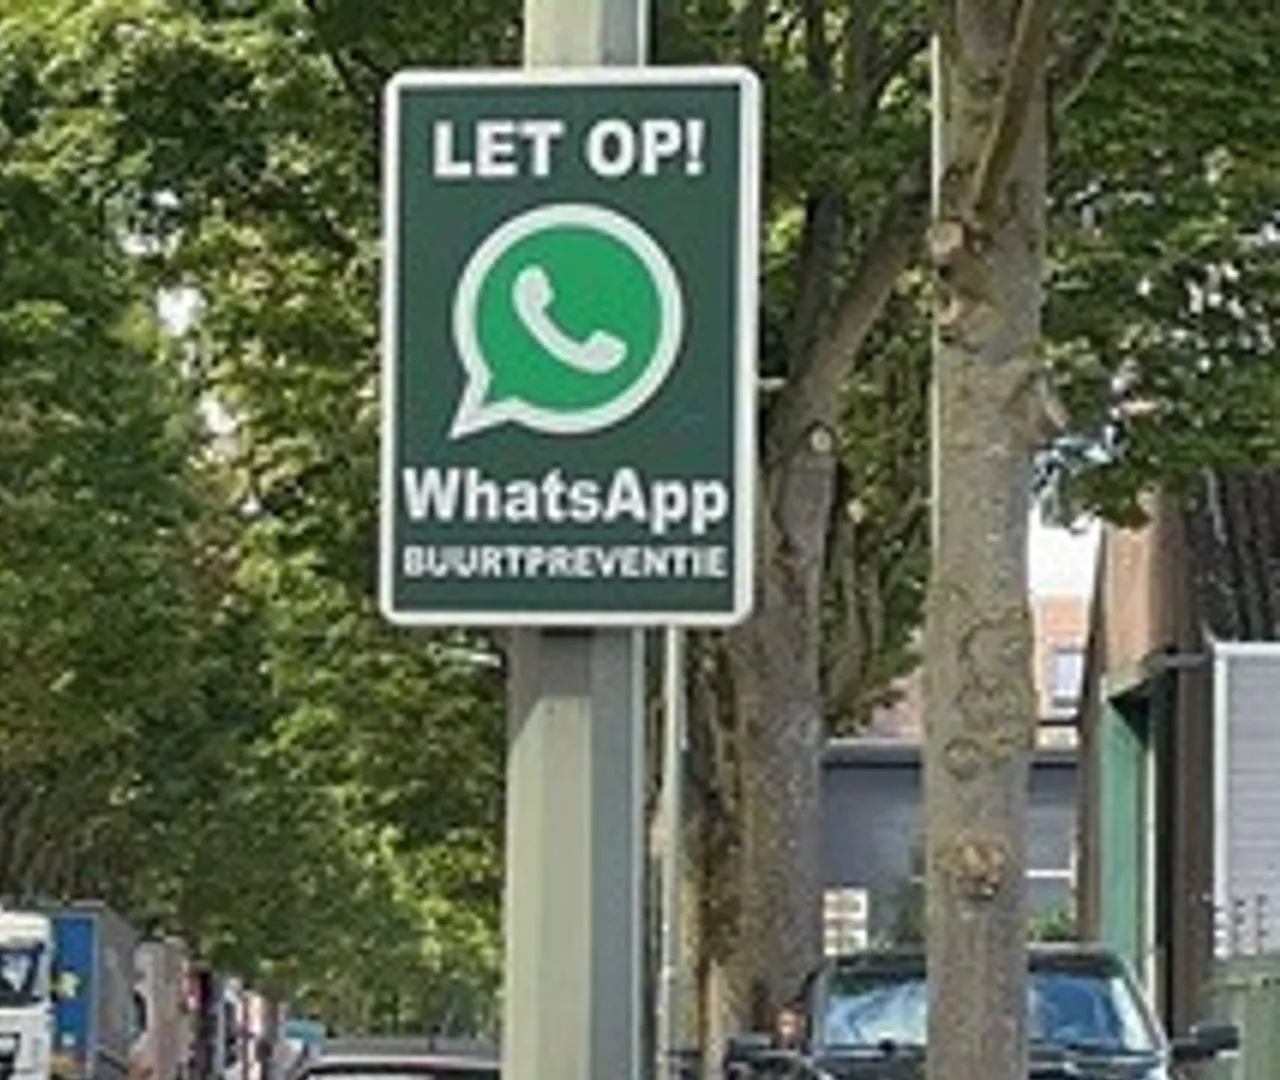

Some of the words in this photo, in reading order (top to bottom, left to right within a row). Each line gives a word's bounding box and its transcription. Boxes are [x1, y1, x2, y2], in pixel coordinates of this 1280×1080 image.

[433, 119, 566, 177] LET
[586, 118, 705, 177] OP!
[402, 467, 730, 534] WhatsApp
[402, 544, 728, 578] BUURTPREVENTIE
